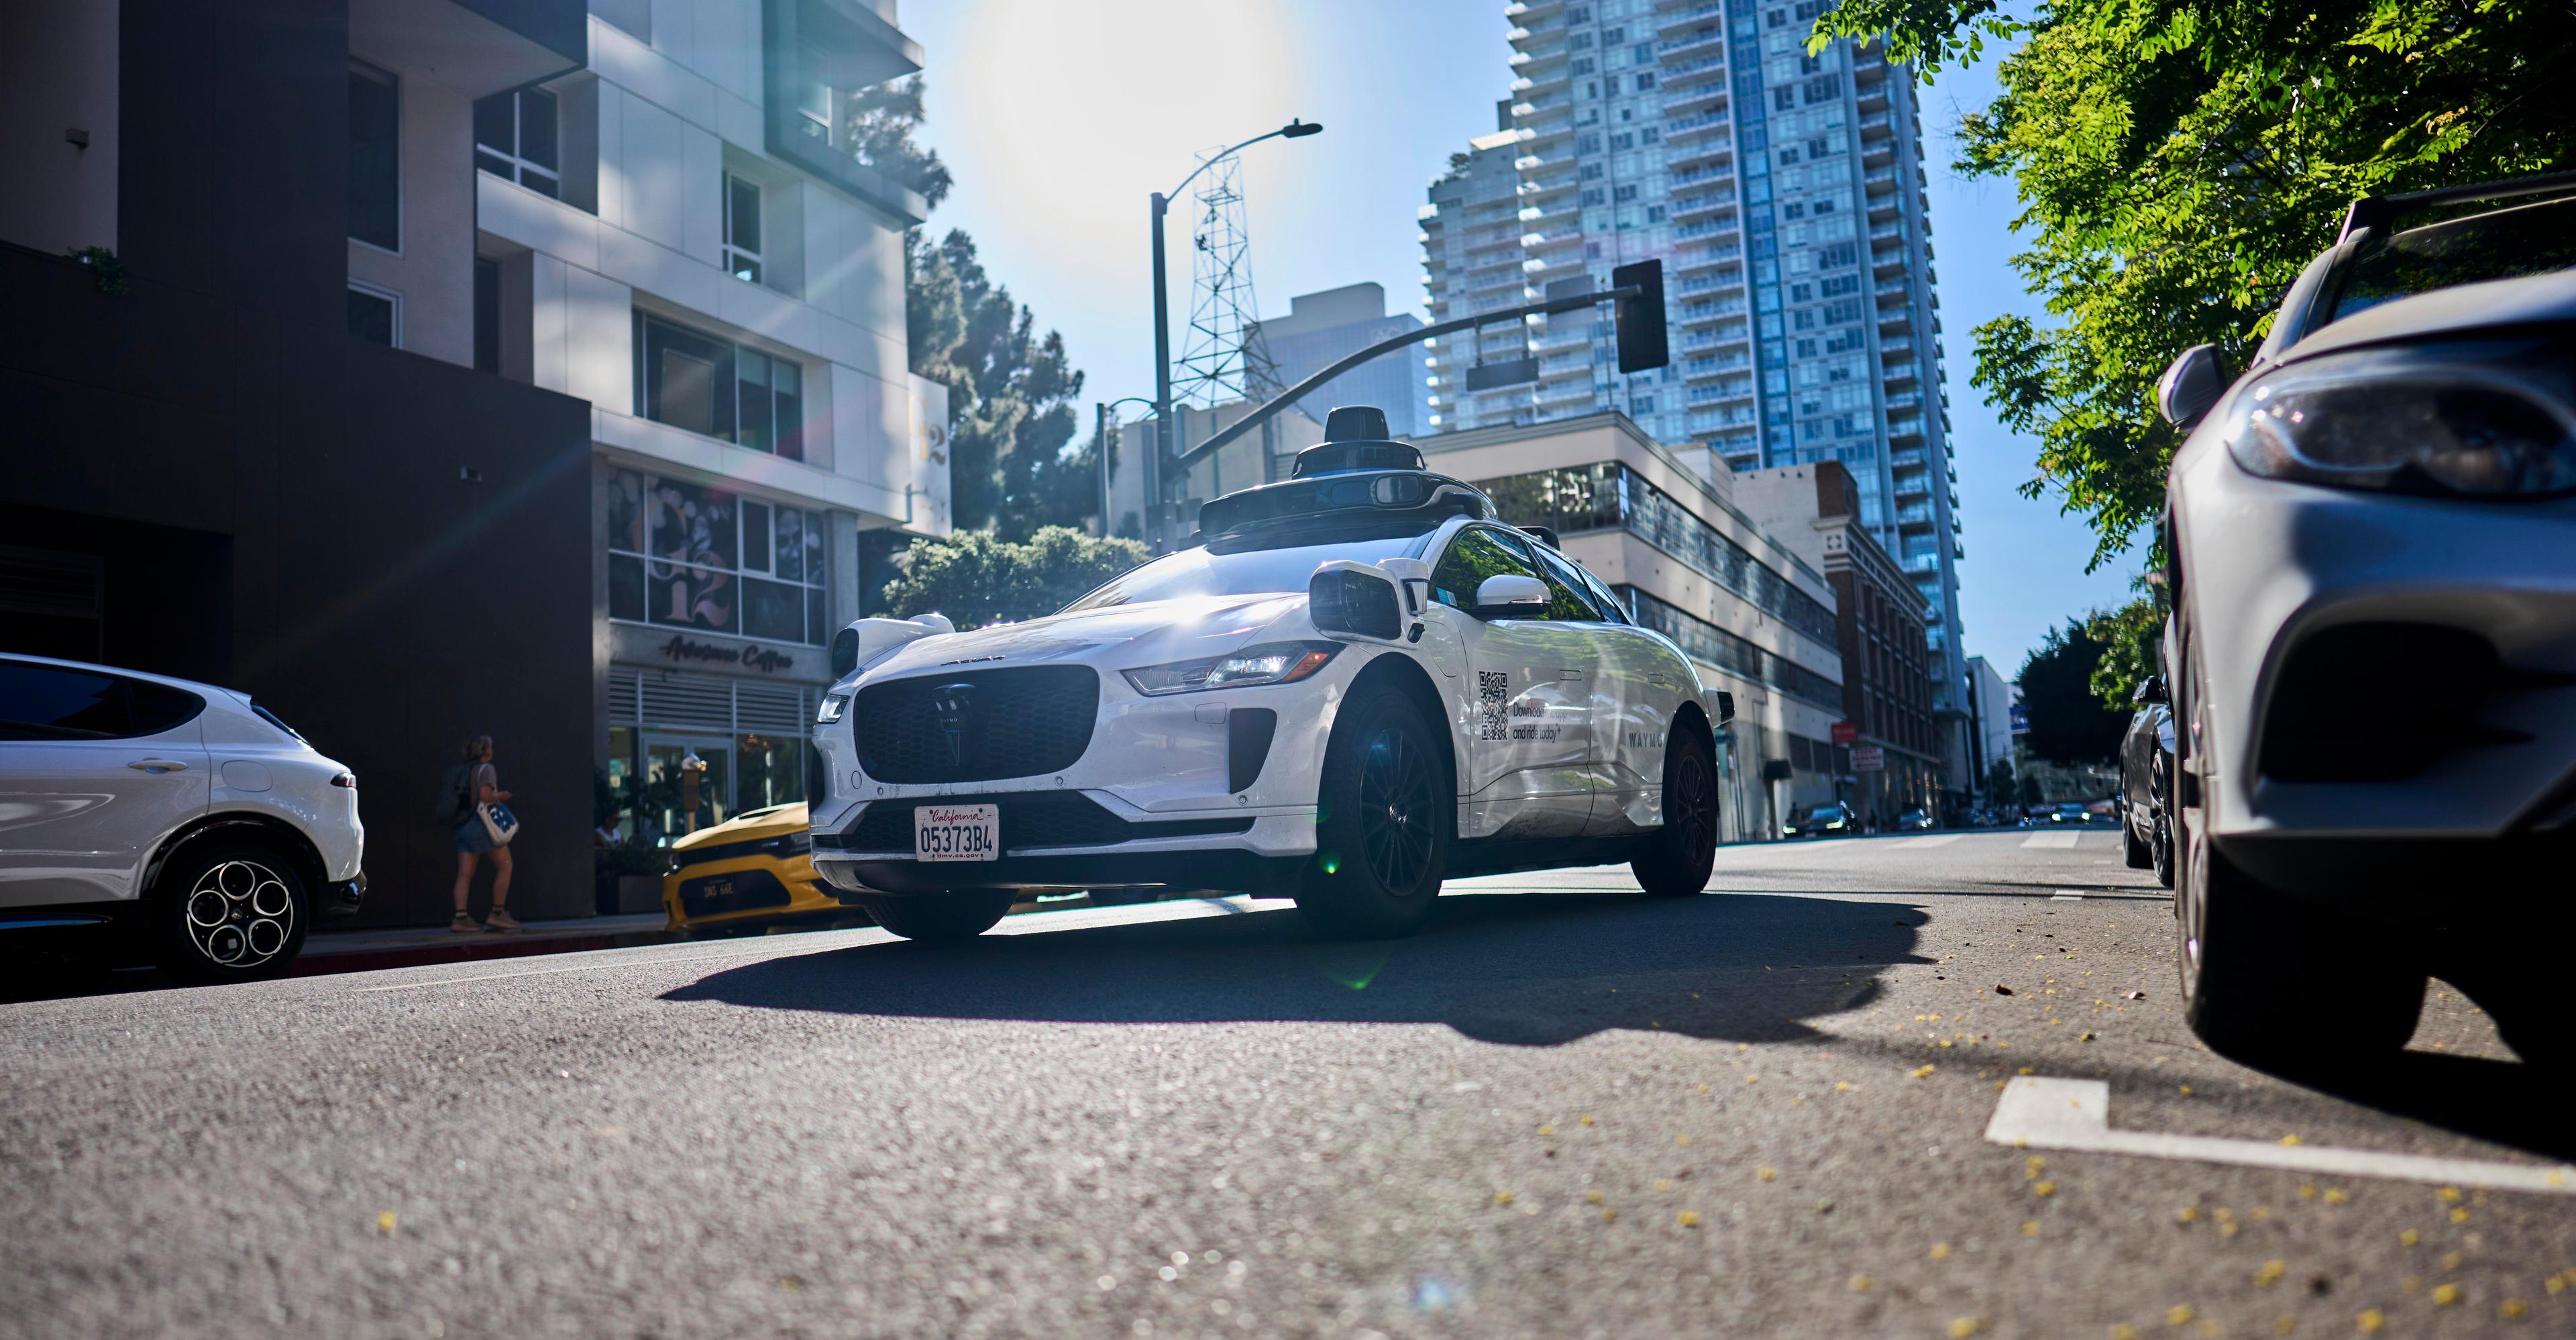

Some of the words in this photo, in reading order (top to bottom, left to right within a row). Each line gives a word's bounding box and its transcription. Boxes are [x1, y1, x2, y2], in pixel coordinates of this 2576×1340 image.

[1513, 725, 1526, 739] and
[1527, 725, 1539, 739] ride
[1540, 725, 1556, 743] today
[1629, 733, 1663, 748] WAYMO
[932, 809, 983, 825] California
[921, 825, 993, 853] 05373B4
